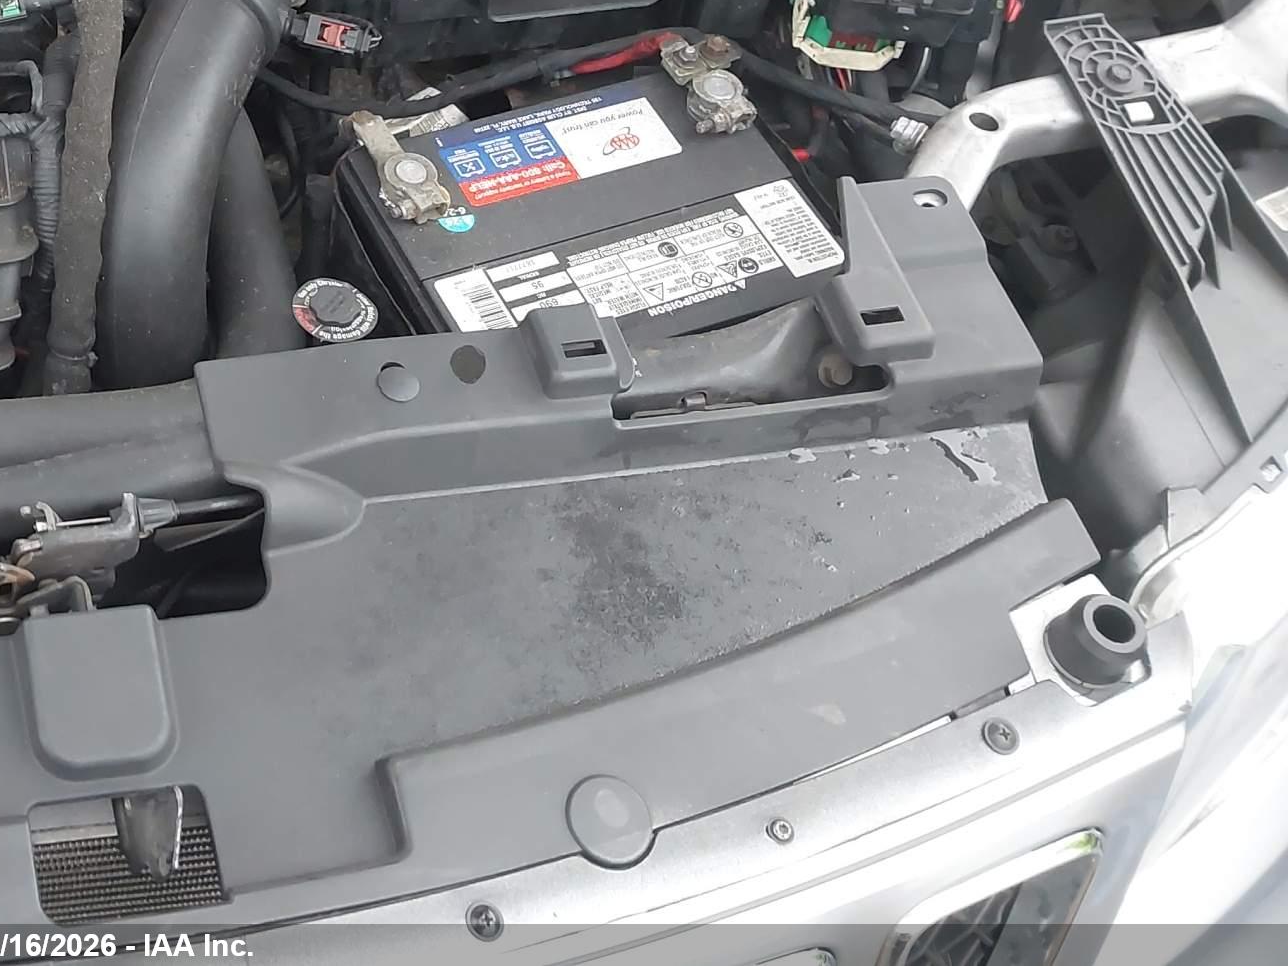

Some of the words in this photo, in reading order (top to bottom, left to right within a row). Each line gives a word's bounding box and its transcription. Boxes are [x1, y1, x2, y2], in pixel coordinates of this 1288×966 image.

[584, 119, 598, 130] can
[599, 113, 615, 126] you
[531, 280, 543, 289] 95
[647, 282, 737, 317] DANGER/POISON
